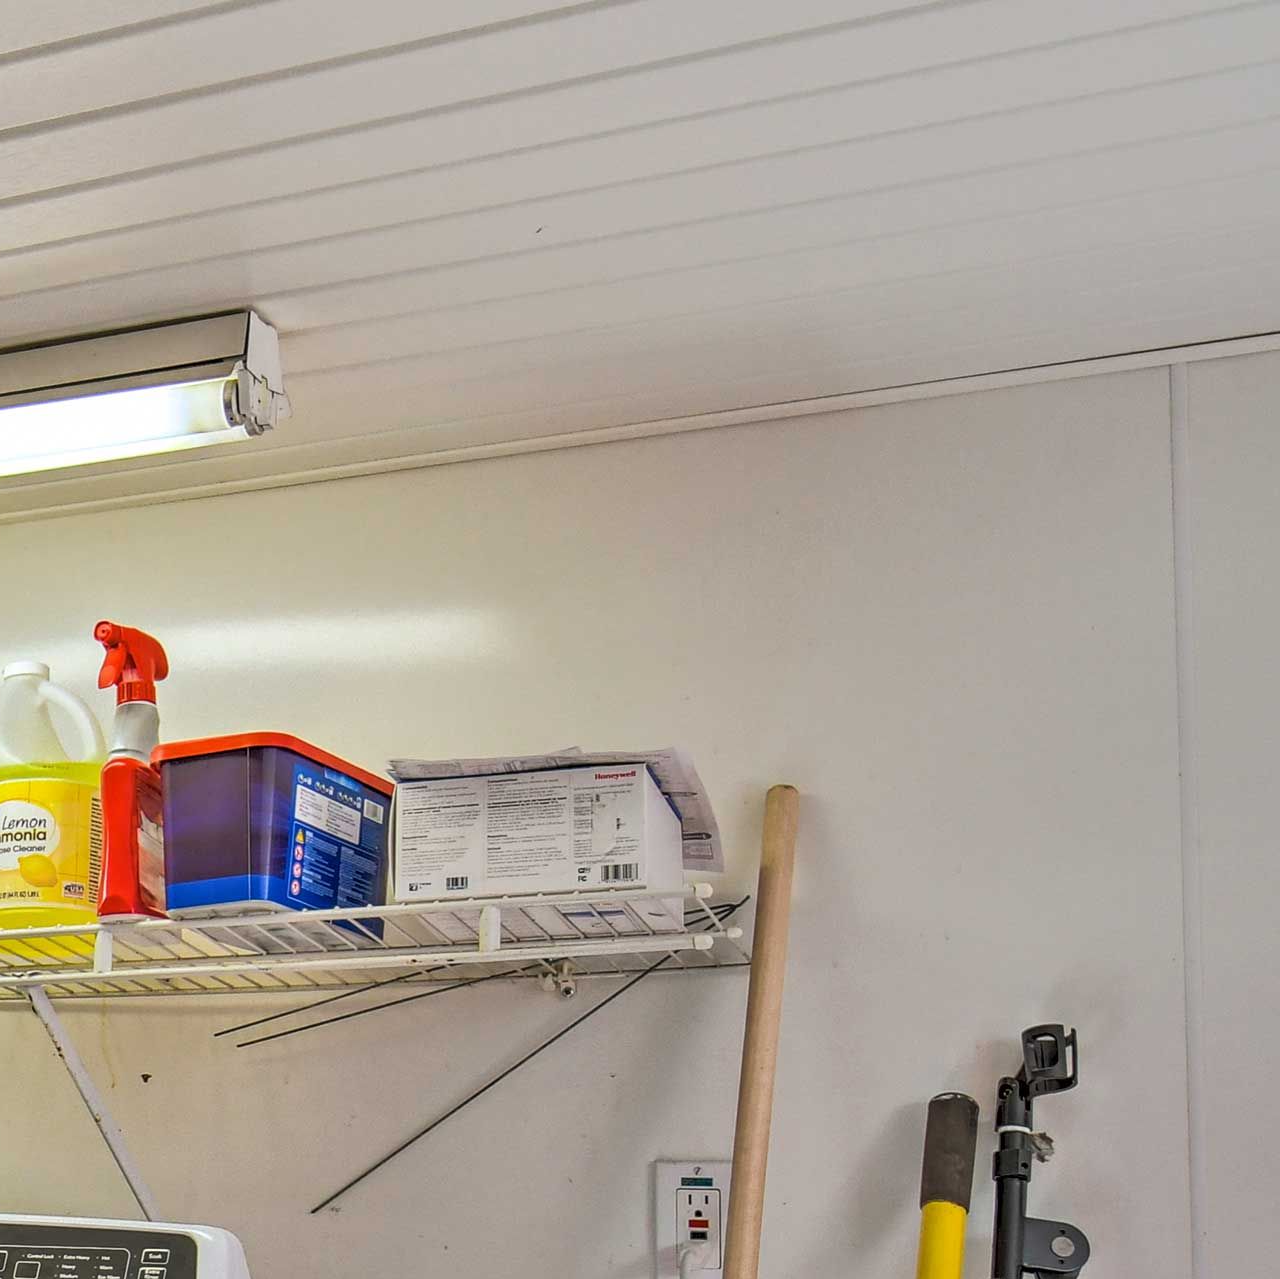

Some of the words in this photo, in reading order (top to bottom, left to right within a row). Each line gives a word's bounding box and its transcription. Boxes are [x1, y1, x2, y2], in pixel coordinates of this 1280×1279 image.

[594, 770, 637, 781] Honeywell
[2, 816, 47, 831] Lemon
[12, 845, 46, 853] Cleaner
